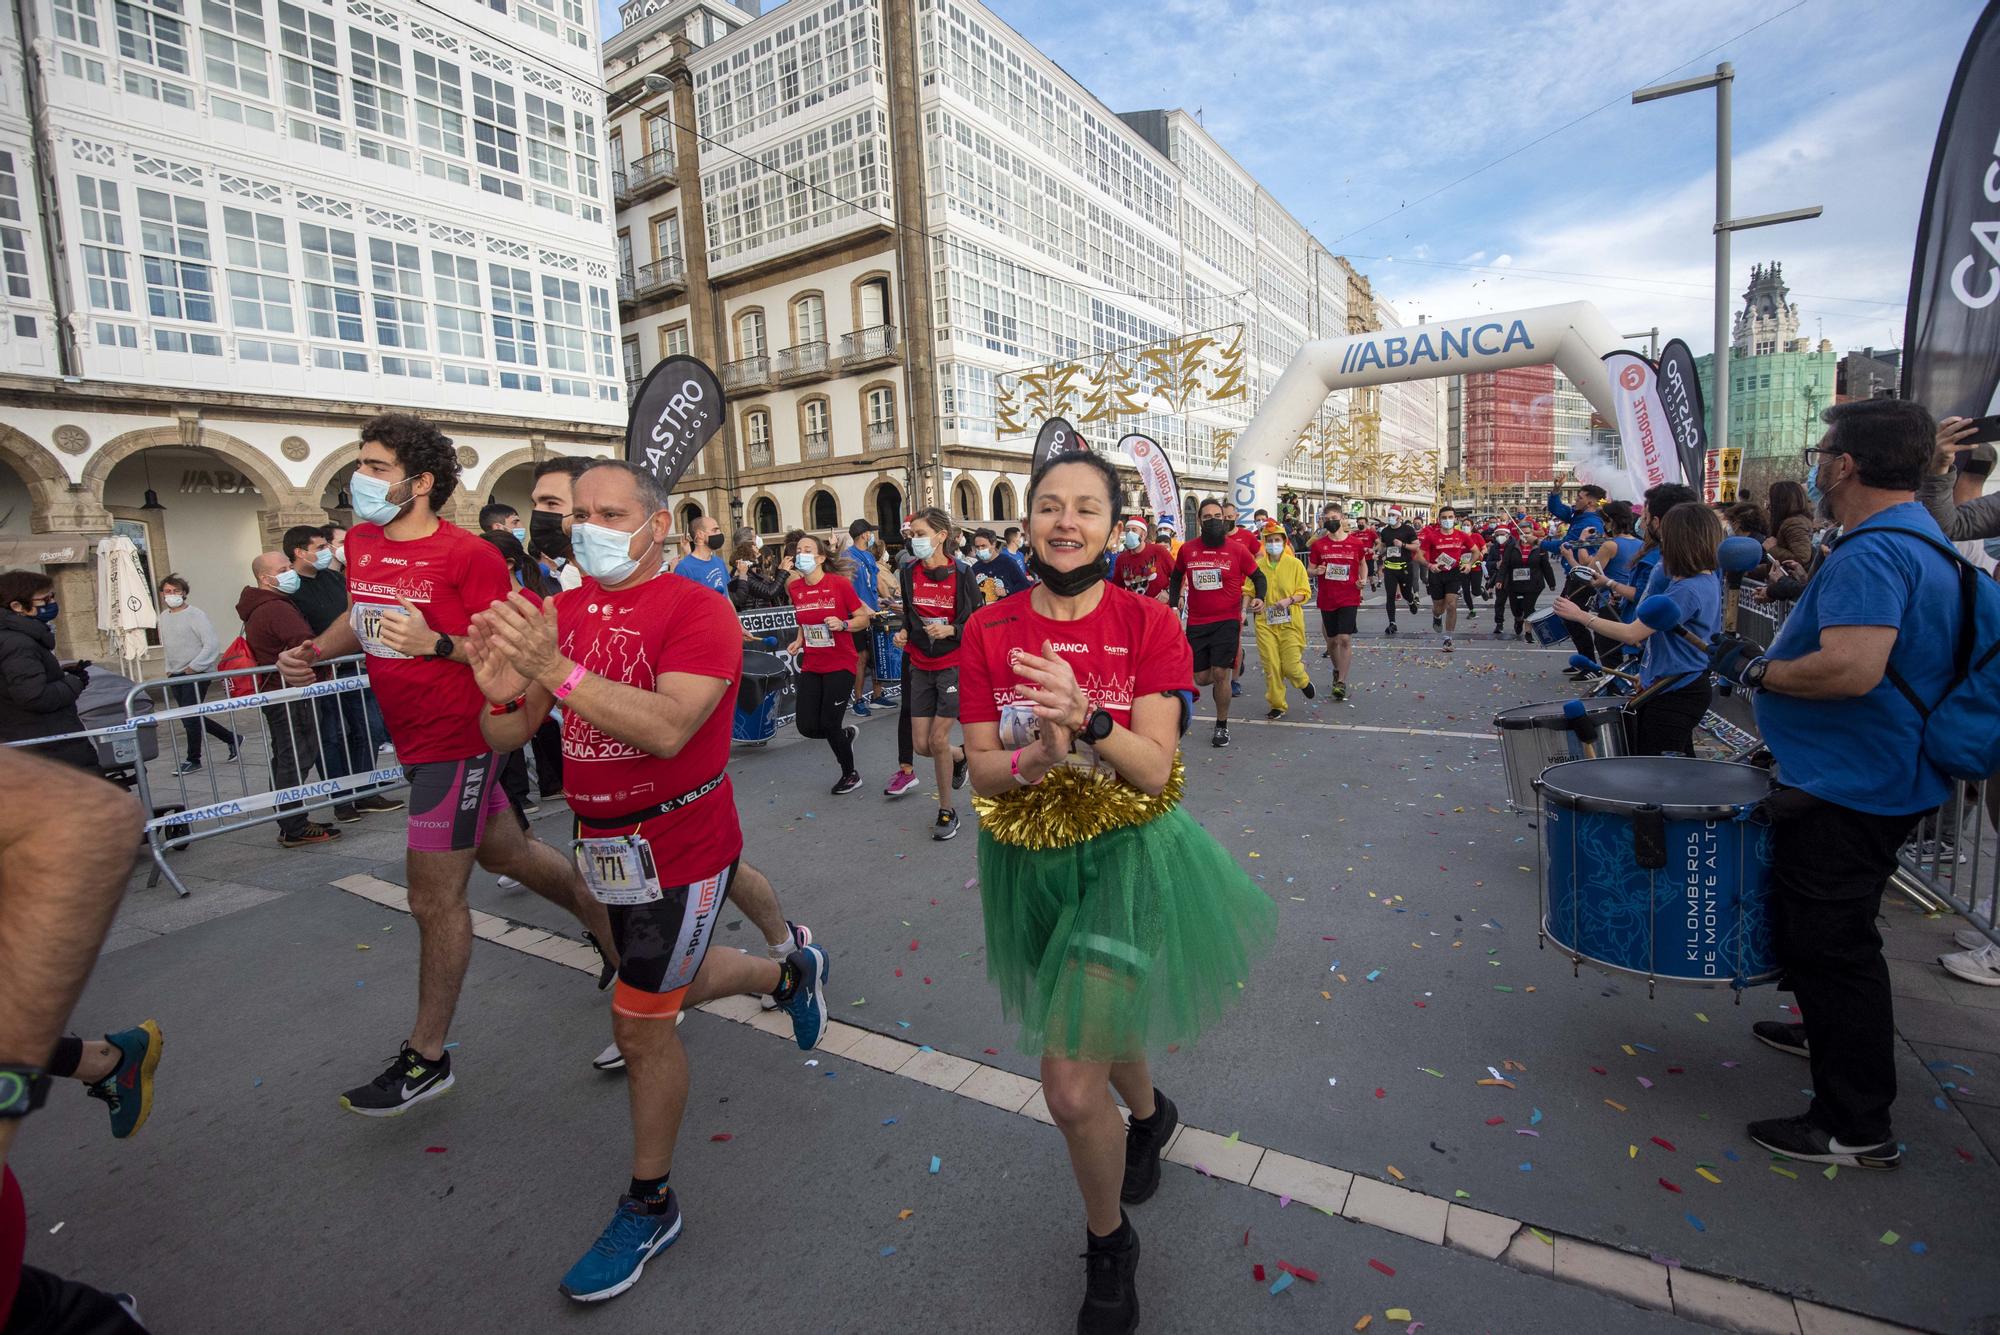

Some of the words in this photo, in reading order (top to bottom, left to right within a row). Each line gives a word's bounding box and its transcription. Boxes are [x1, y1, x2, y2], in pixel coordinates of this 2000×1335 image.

[640, 380, 703, 477] ASTRO
[596, 856, 626, 881] 771
[1686, 832, 1699, 961] KILOMBEROS
[1705, 875, 1717, 944] MONTE
[1704, 951, 1716, 976] DE
